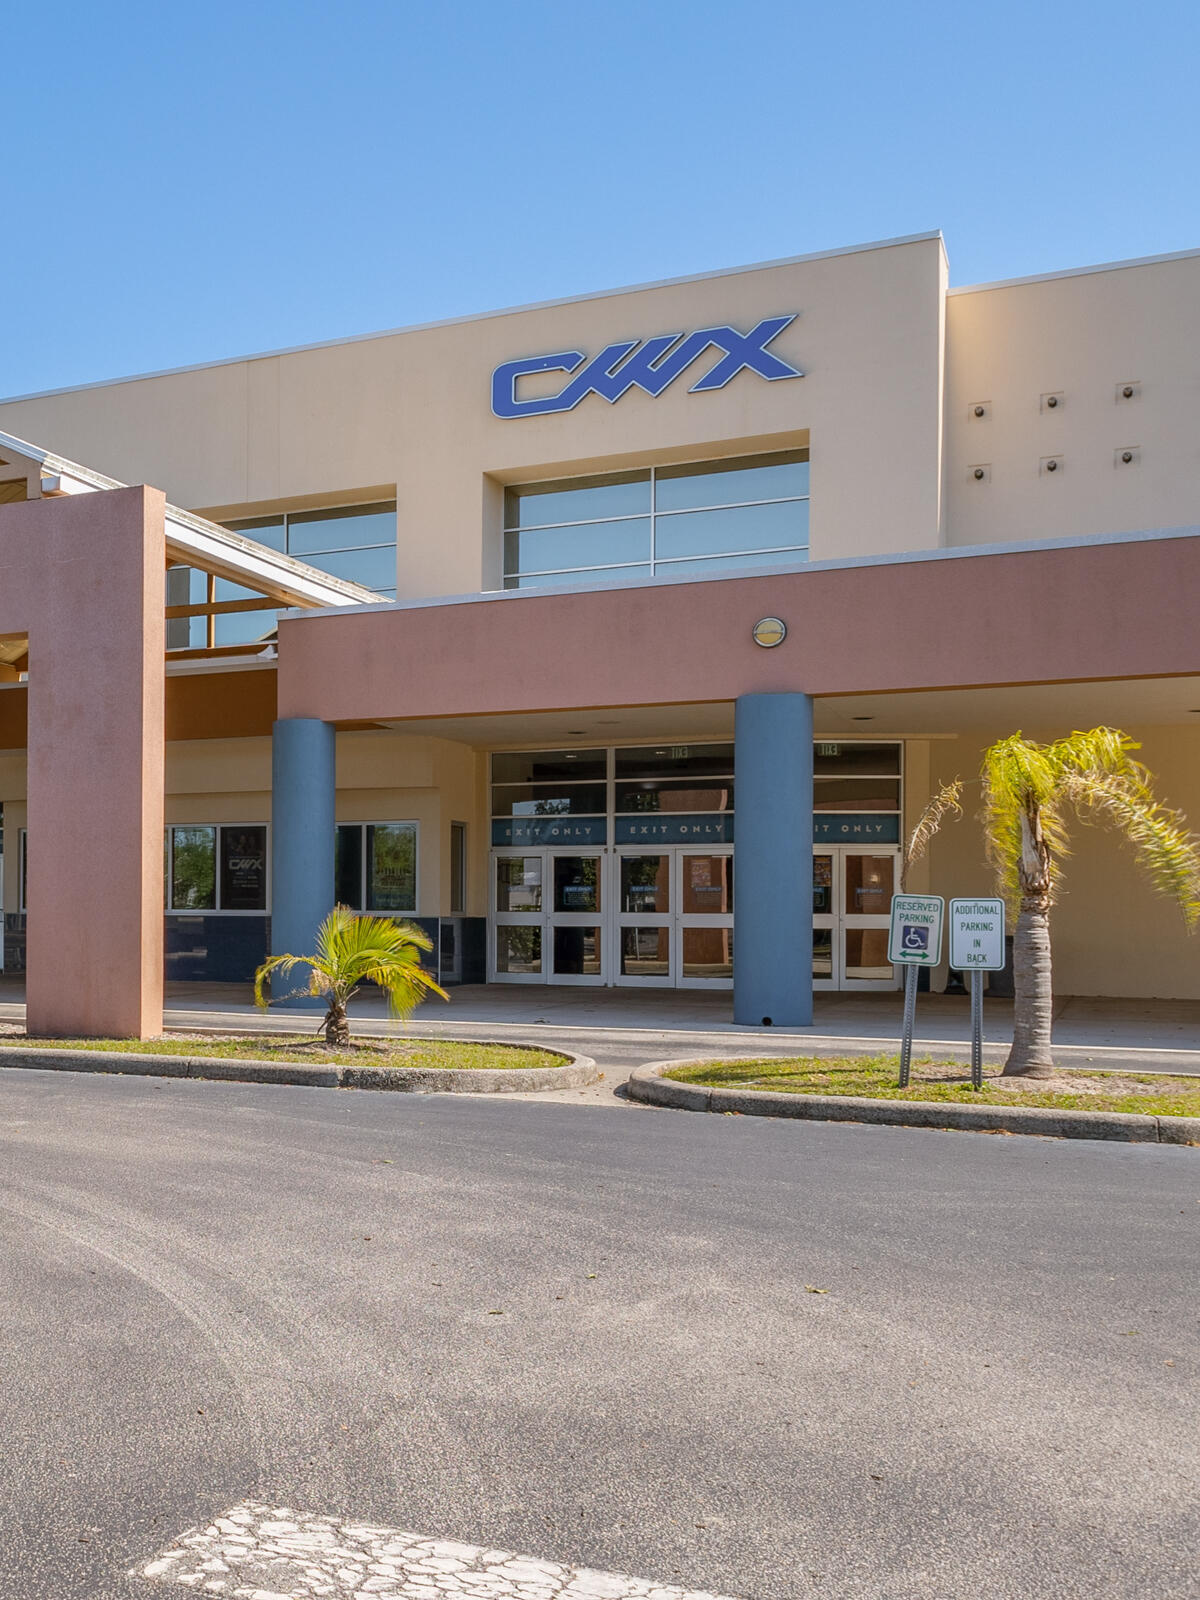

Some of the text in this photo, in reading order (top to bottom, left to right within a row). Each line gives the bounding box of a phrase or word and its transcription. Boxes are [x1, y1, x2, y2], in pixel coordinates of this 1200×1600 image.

[492, 314, 804, 419] CWX
[505, 827, 592, 836] EXIT ONLY
[630, 824, 724, 834] EXIT ONLY
[841, 824, 883, 833] ONLY
[896, 901, 939, 912] RESERVED
[954, 905, 1000, 915] ADDITIONAL
[898, 913, 935, 924] PARKING
[960, 922, 994, 931] PARKING
[973, 939, 981, 948] IN
[966, 953, 988, 963] BACK
